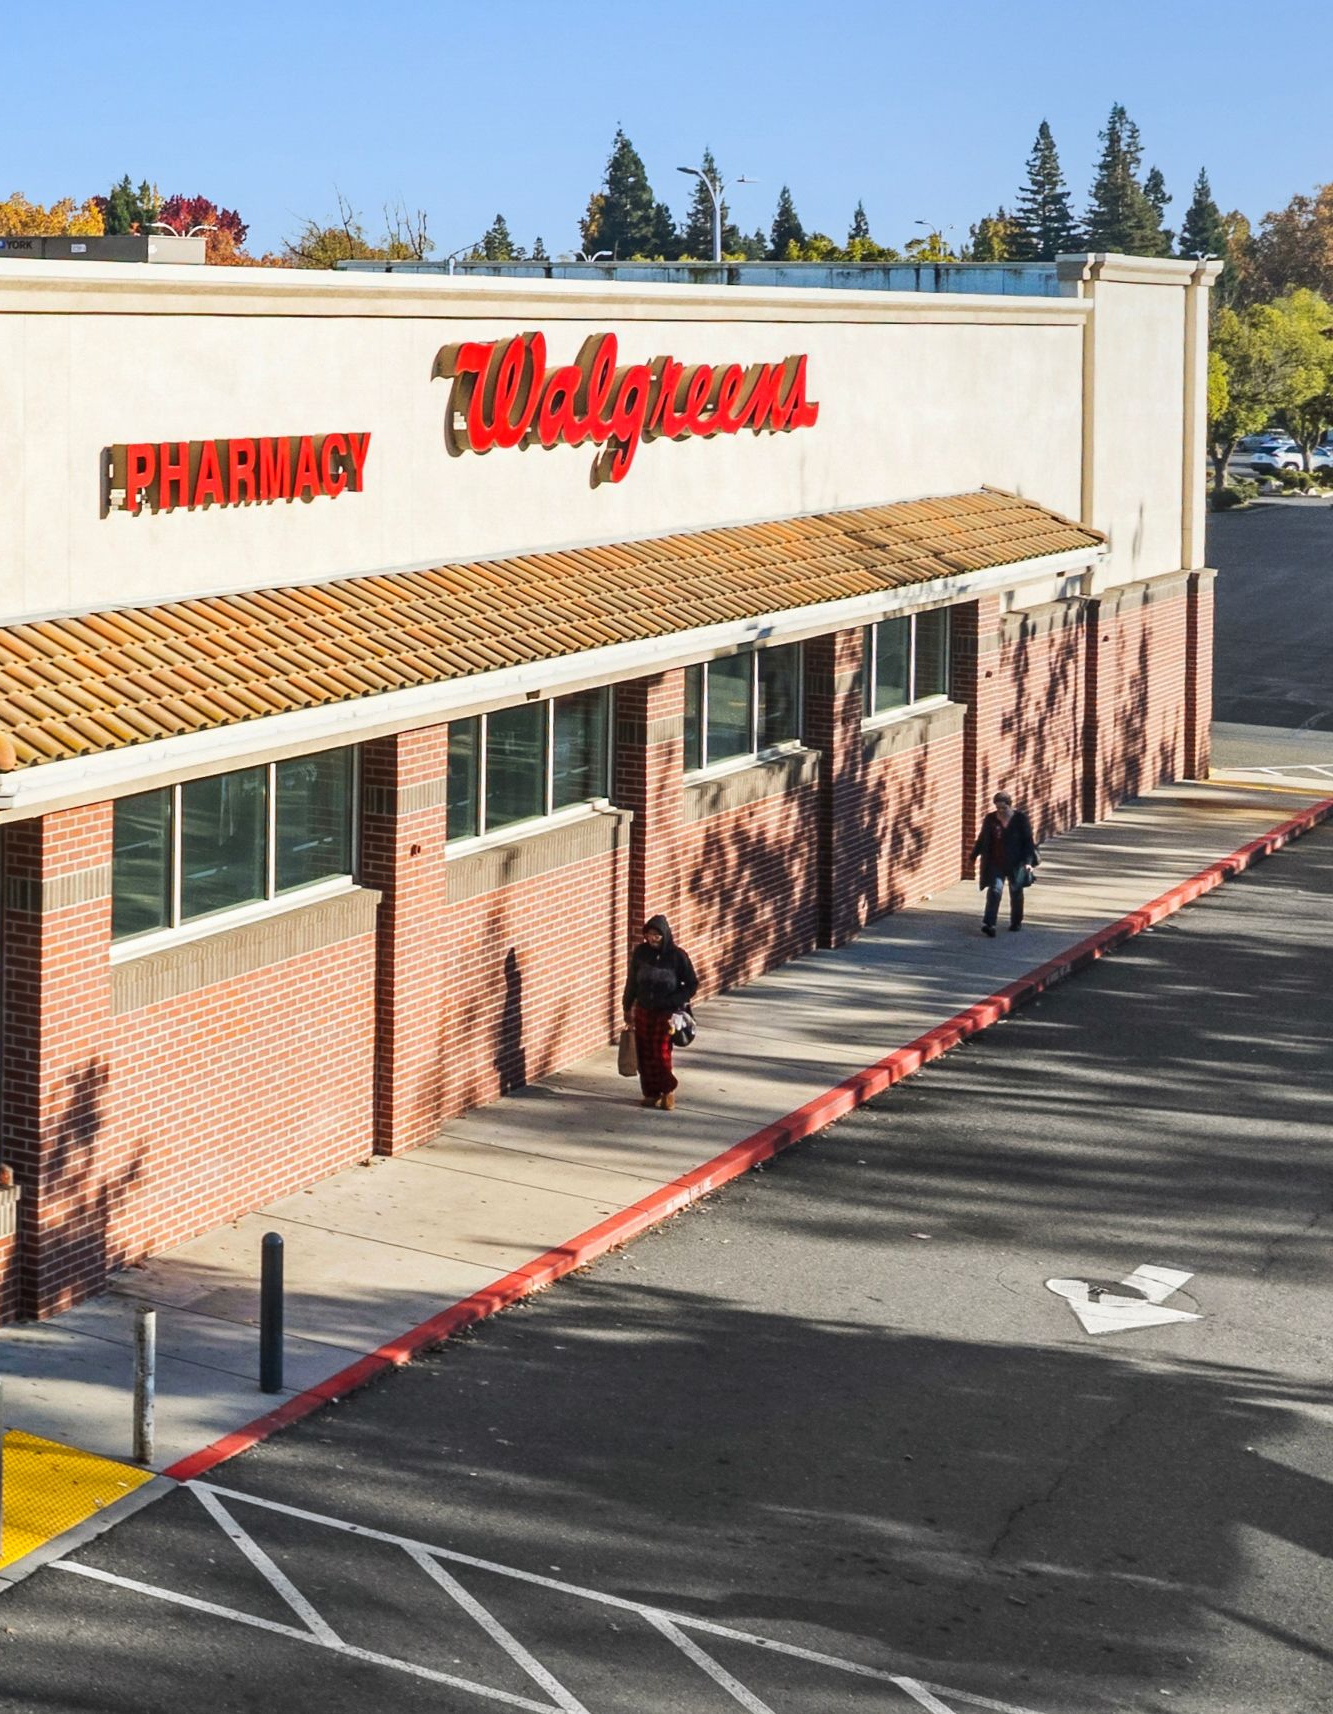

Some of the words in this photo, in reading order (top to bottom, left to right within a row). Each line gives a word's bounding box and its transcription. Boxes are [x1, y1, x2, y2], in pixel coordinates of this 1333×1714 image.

[6, 240, 33, 250] YORK
[437, 331, 820, 487] Walgreens
[118, 432, 372, 515] PHARMACY
